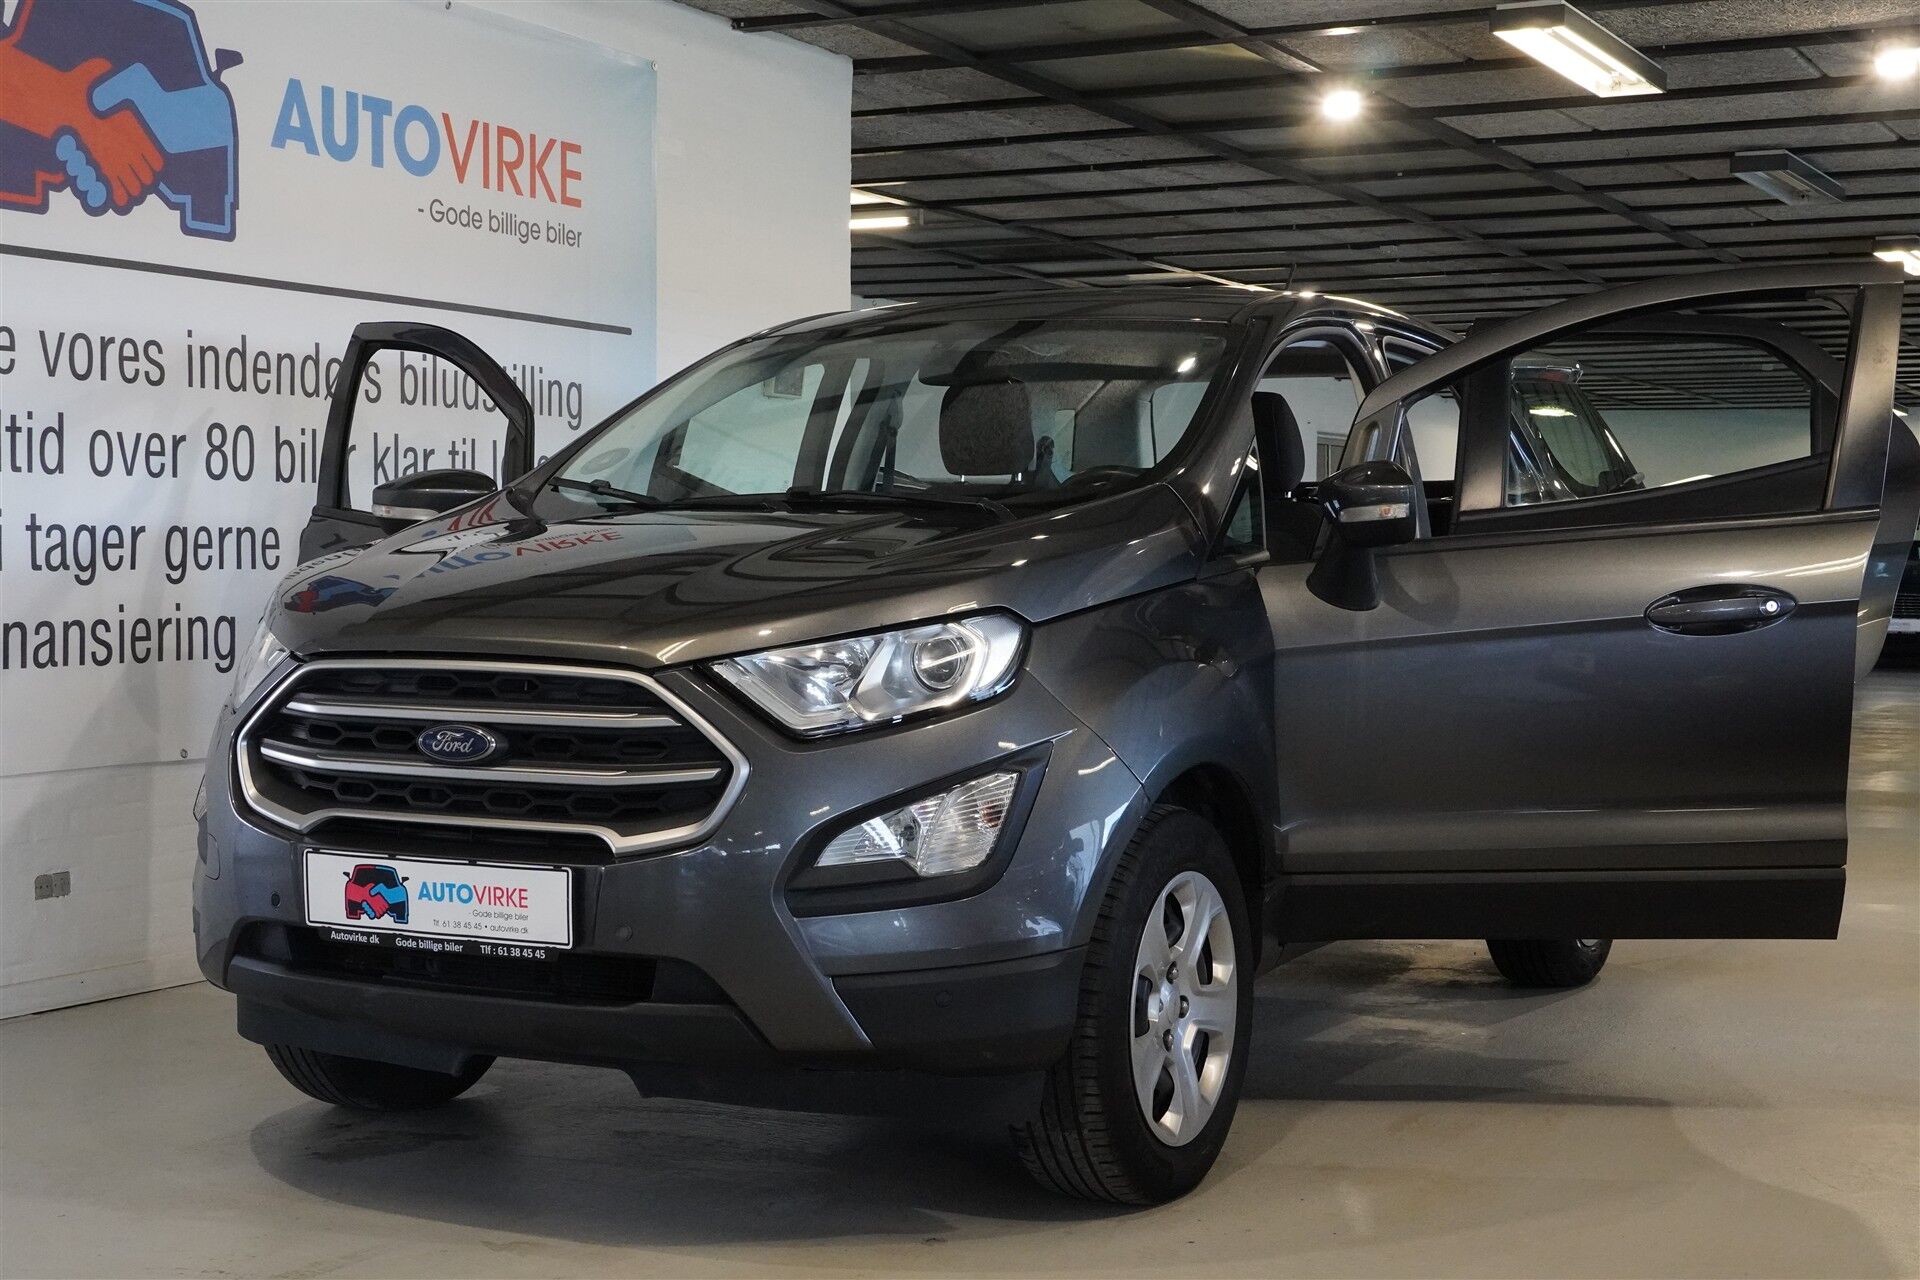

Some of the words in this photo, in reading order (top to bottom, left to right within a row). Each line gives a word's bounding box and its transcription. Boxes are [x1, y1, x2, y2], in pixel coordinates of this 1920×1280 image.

[271, 78, 582, 209] AUTOVIRKE
[430, 199, 483, 230] Gode
[488, 209, 541, 244] billige
[546, 220, 582, 248] biler
[39, 330, 165, 387] vores
[187, 330, 381, 404] indendøs
[0, 410, 64, 476] tid
[89, 430, 187, 479] over
[206, 422, 256, 482] 80
[275, 426, 356, 483] bil
[25, 513, 146, 586] tager
[165, 526, 280, 585] gerne
[432, 730, 475, 753] Ford
[417, 881, 528, 908] AUTOVIRKE
[442, 920, 450, 928] 61
[453, 921, 461, 929] 38
[463, 922, 472, 930] 45
[473, 922, 482, 931] 45
[472, 909, 492, 919] Gode
[493, 911, 513, 921] billige
[514, 913, 528, 921] biler
[395, 937, 417, 948] Gode
[418, 939, 443, 951] billige
[444, 941, 463, 952] biler
[480, 945, 491, 954] Tlf
[497, 946, 508, 956] 61
[510, 947, 520, 957] 38
[522, 948, 533, 958] 45
[534, 949, 545, 959] 45
